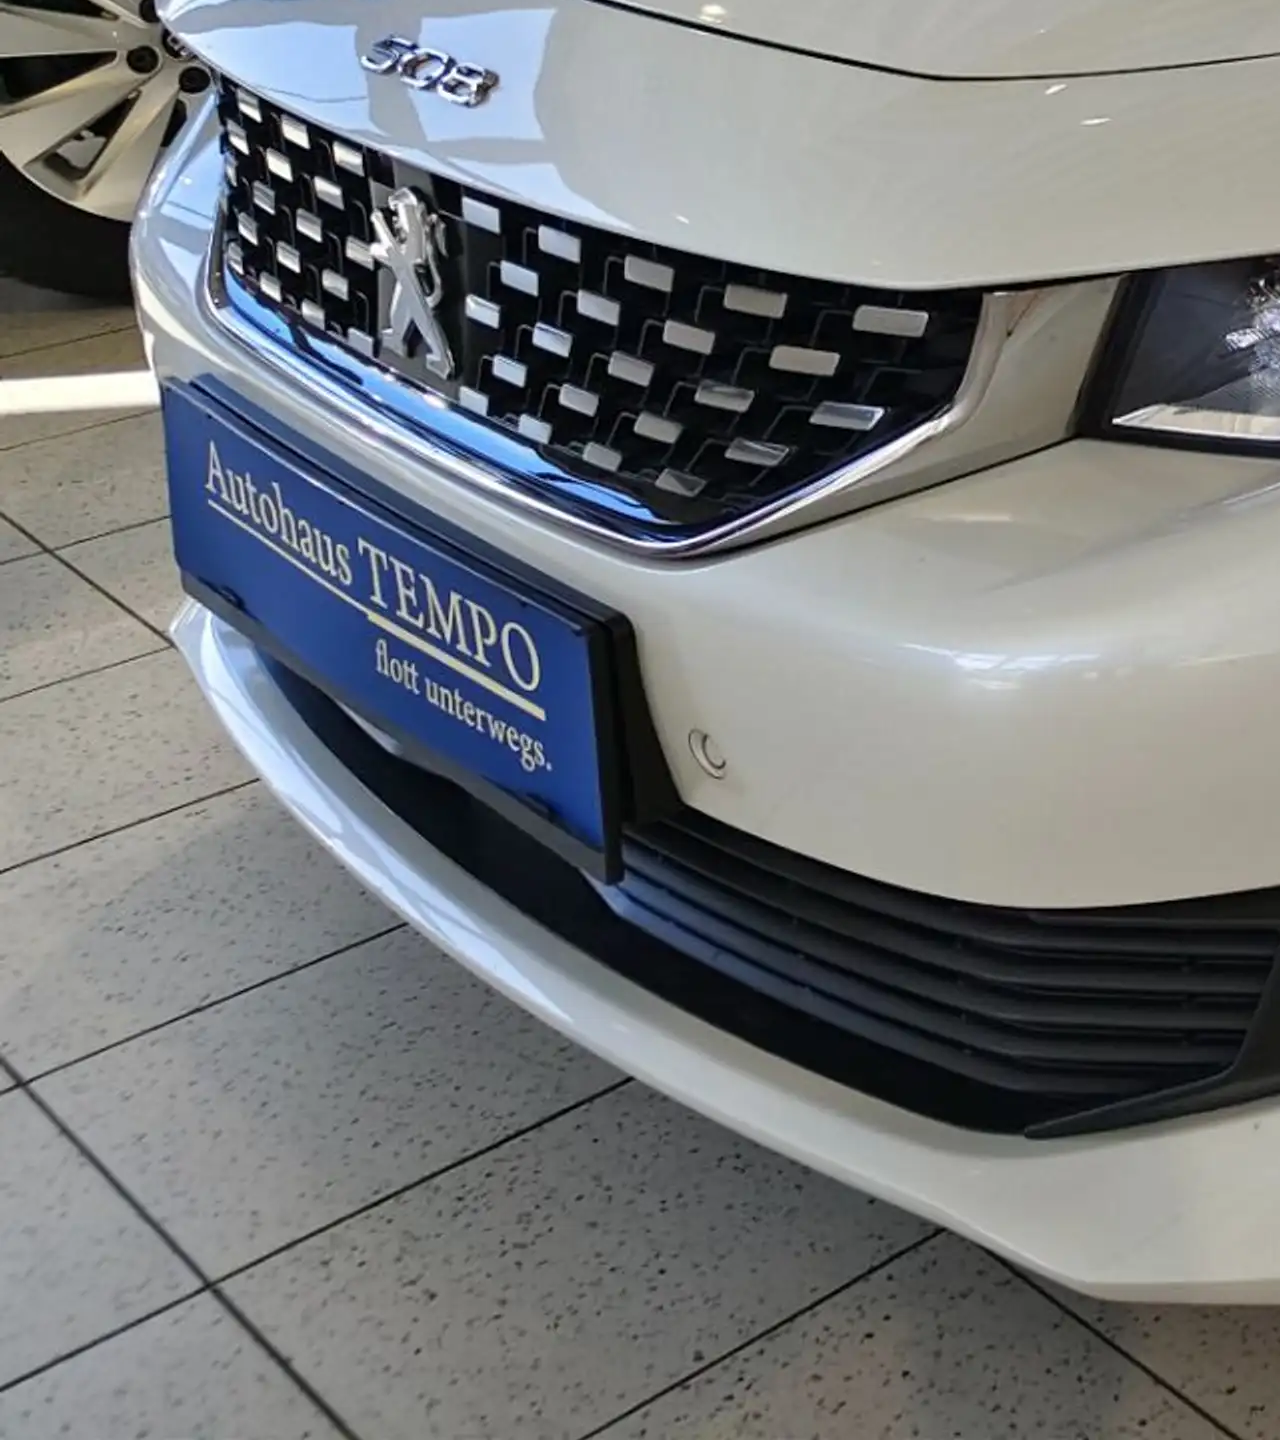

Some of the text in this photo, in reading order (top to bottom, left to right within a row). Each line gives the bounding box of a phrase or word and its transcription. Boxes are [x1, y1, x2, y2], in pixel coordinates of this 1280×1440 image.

[361, 34, 500, 107] 508
[205, 441, 541, 691] Autohaus TEMPO
[375, 638, 552, 771] flott unterwegs.
